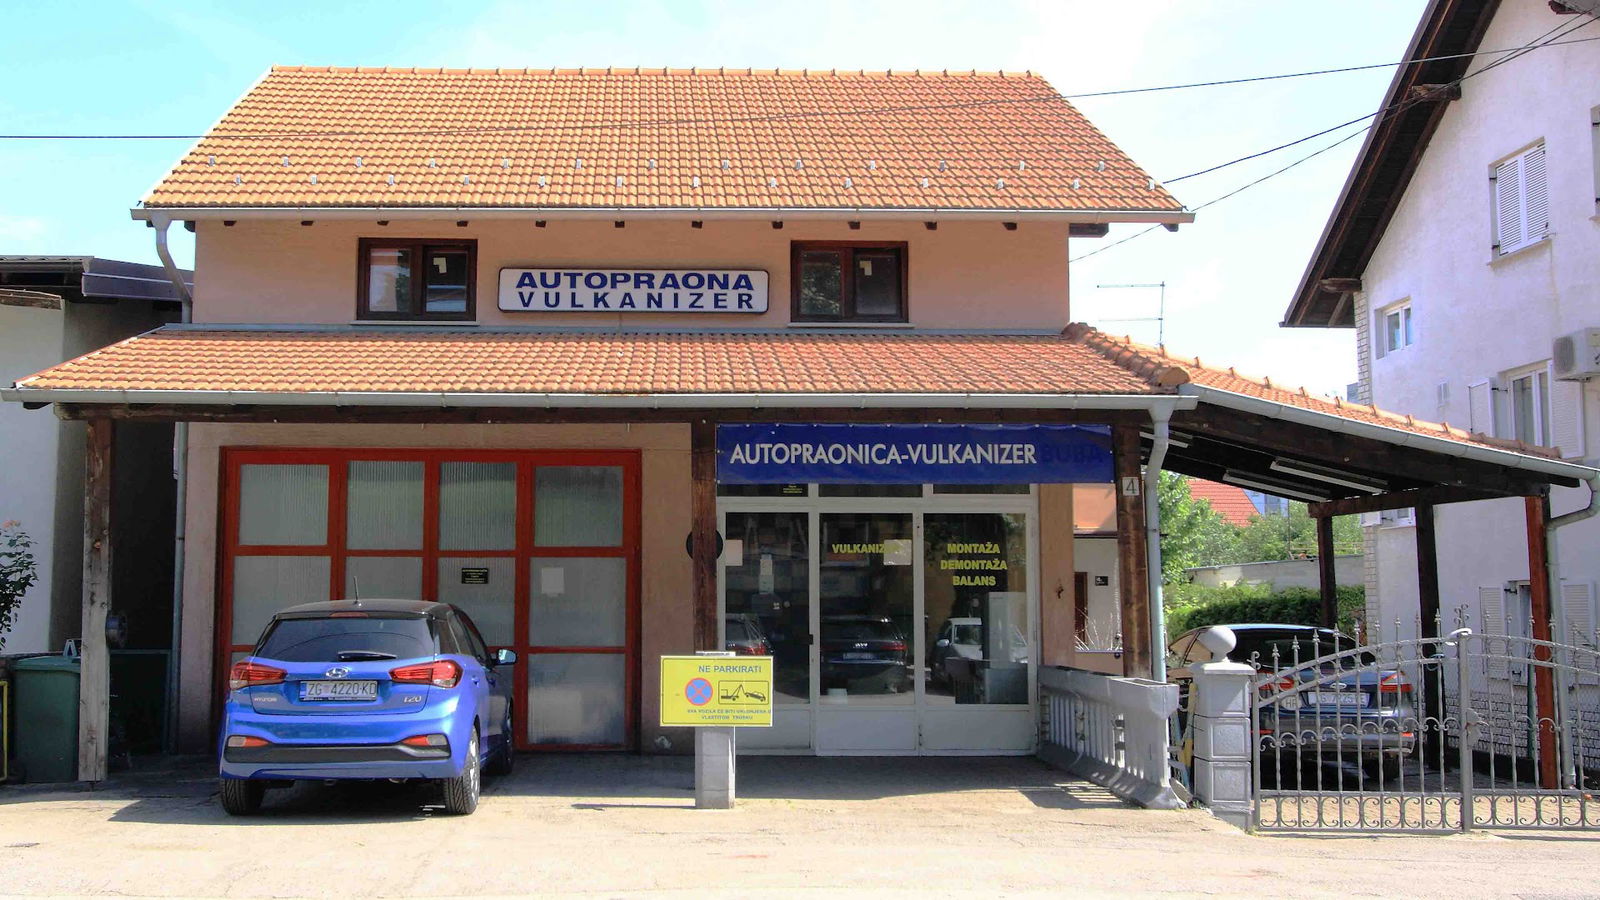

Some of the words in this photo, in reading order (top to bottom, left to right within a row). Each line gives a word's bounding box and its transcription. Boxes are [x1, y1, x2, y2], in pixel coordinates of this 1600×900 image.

[516, 272, 754, 290] AUTOPRAONA
[518, 292, 754, 309] VULKANIZER
[730, 443, 1037, 465] AUTOPRAONICA-VULKANIZER
[1126, 478, 1137, 494] 4
[832, 543, 899, 554] VULKANIZ
[947, 542, 1000, 554] MONTAŽA
[940, 558, 1008, 570] DEMONTAŽA
[953, 576, 996, 587] BALANS
[698, 665, 710, 673] NE
[713, 665, 762, 673] PARKIRATI
[307, 682, 323, 696] ZG
